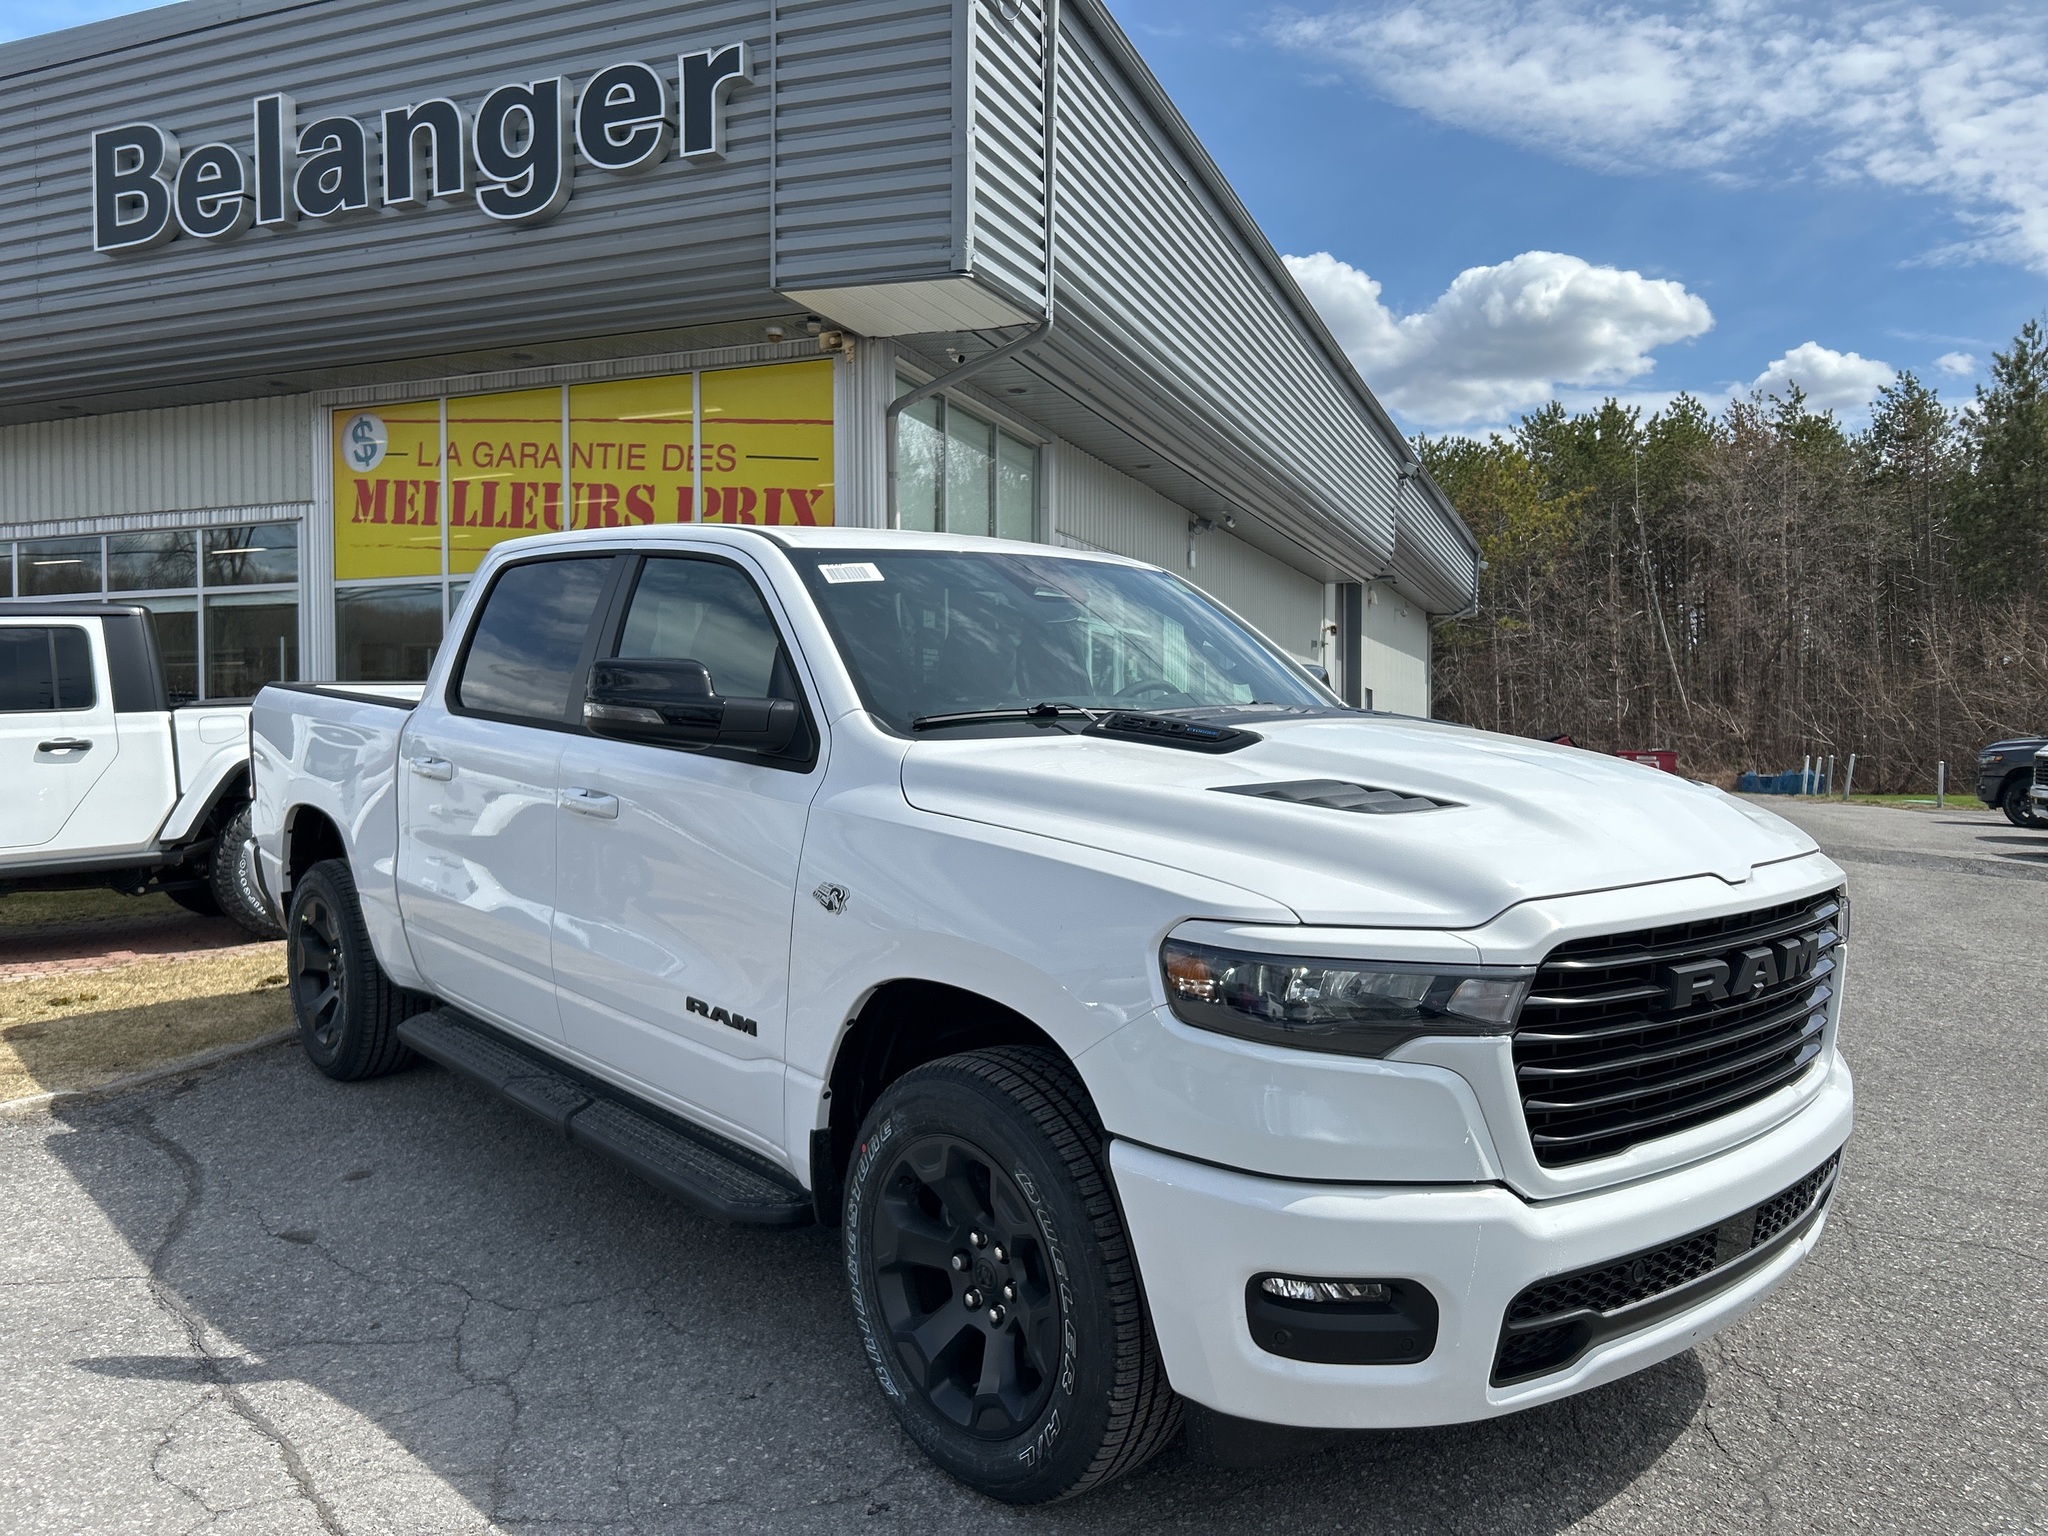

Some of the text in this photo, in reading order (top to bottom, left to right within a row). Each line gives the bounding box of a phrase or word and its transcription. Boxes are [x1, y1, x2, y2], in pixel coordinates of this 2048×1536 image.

[92, 41, 753, 254] Belanger
[417, 441, 737, 473] LA GARANTIE DES
[352, 479, 828, 531] MEILLEURS PRIX
[1660, 932, 1818, 1011] RAM
[685, 996, 758, 1037] RAM
[845, 1118, 900, 1398] BRIDGESTONE
[1015, 1173, 1078, 1396] DUELER
